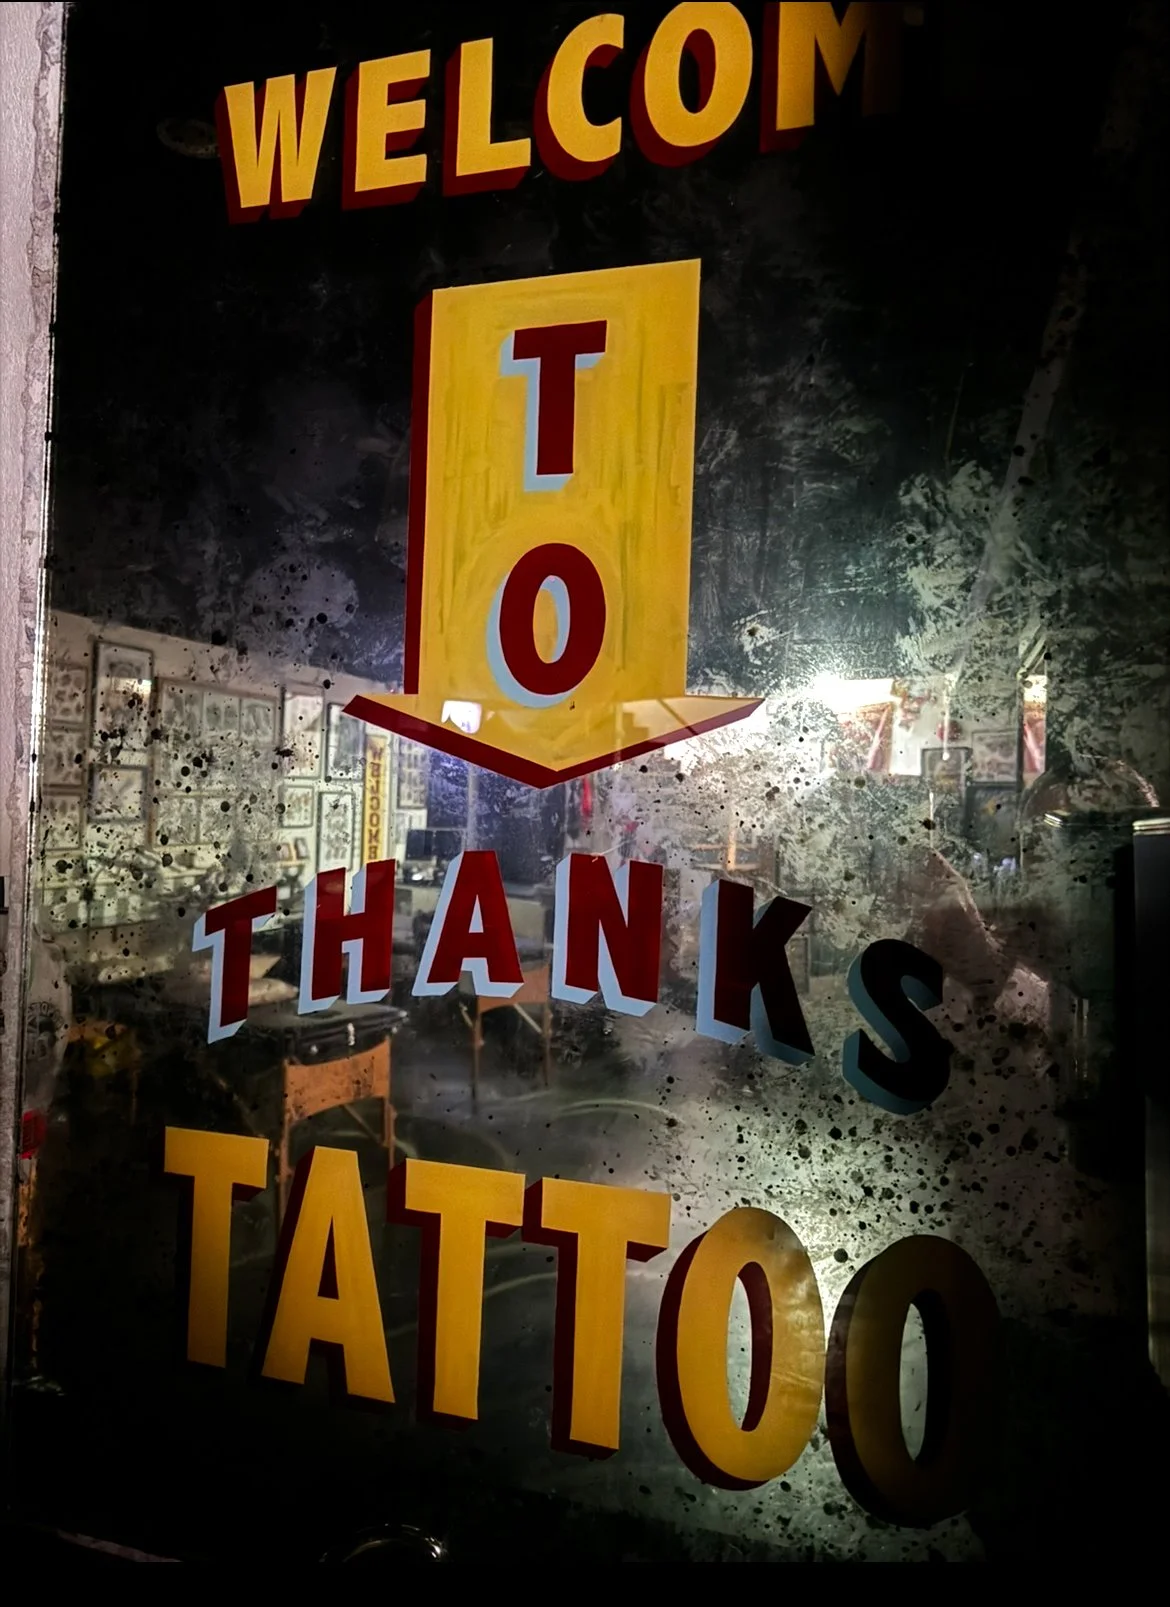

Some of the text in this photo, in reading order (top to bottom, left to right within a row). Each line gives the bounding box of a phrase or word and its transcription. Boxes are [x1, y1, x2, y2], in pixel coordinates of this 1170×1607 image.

[486, 320, 607, 708] TO
[192, 849, 951, 1115] THANKS
[160, 1125, 1001, 1529] TATTOO
